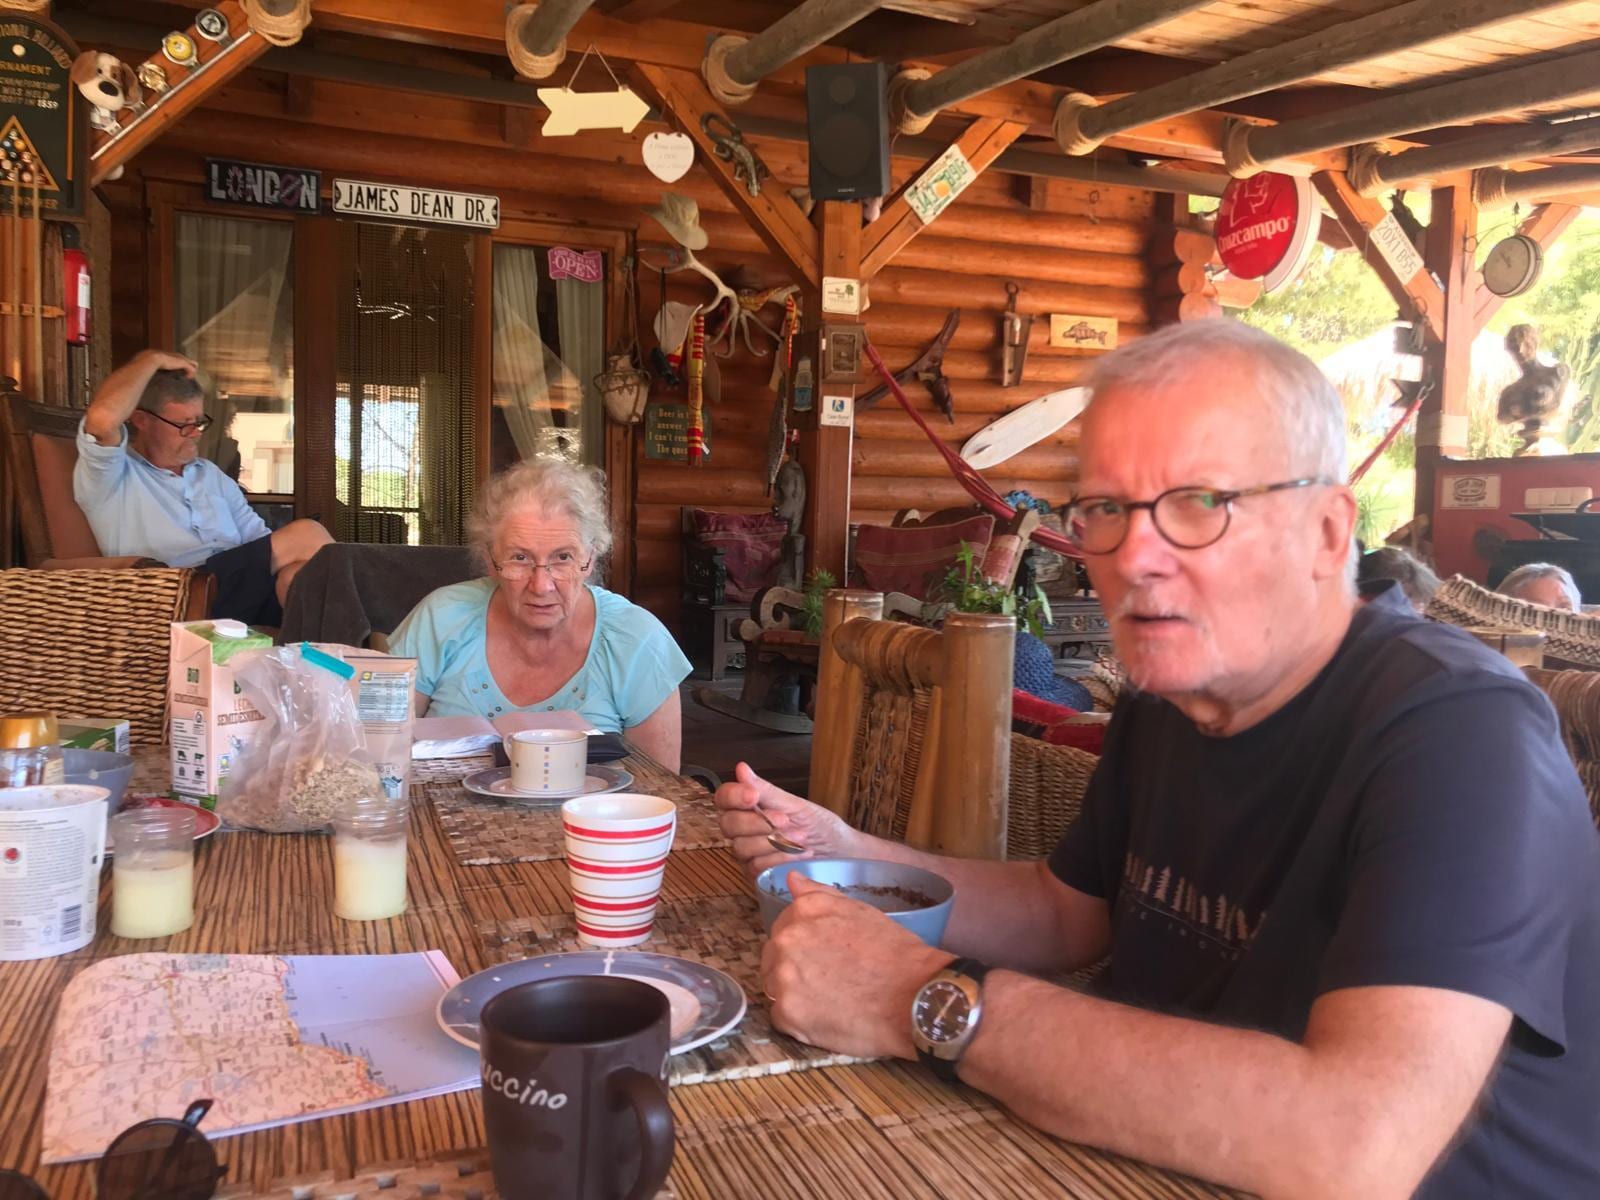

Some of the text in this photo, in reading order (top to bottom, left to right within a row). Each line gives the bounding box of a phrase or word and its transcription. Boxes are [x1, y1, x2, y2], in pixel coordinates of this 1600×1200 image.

[211, 163, 317, 210] LONDON
[343, 184, 491, 224] JAMES DEAN DR.
[555, 255, 598, 279] OPEN
